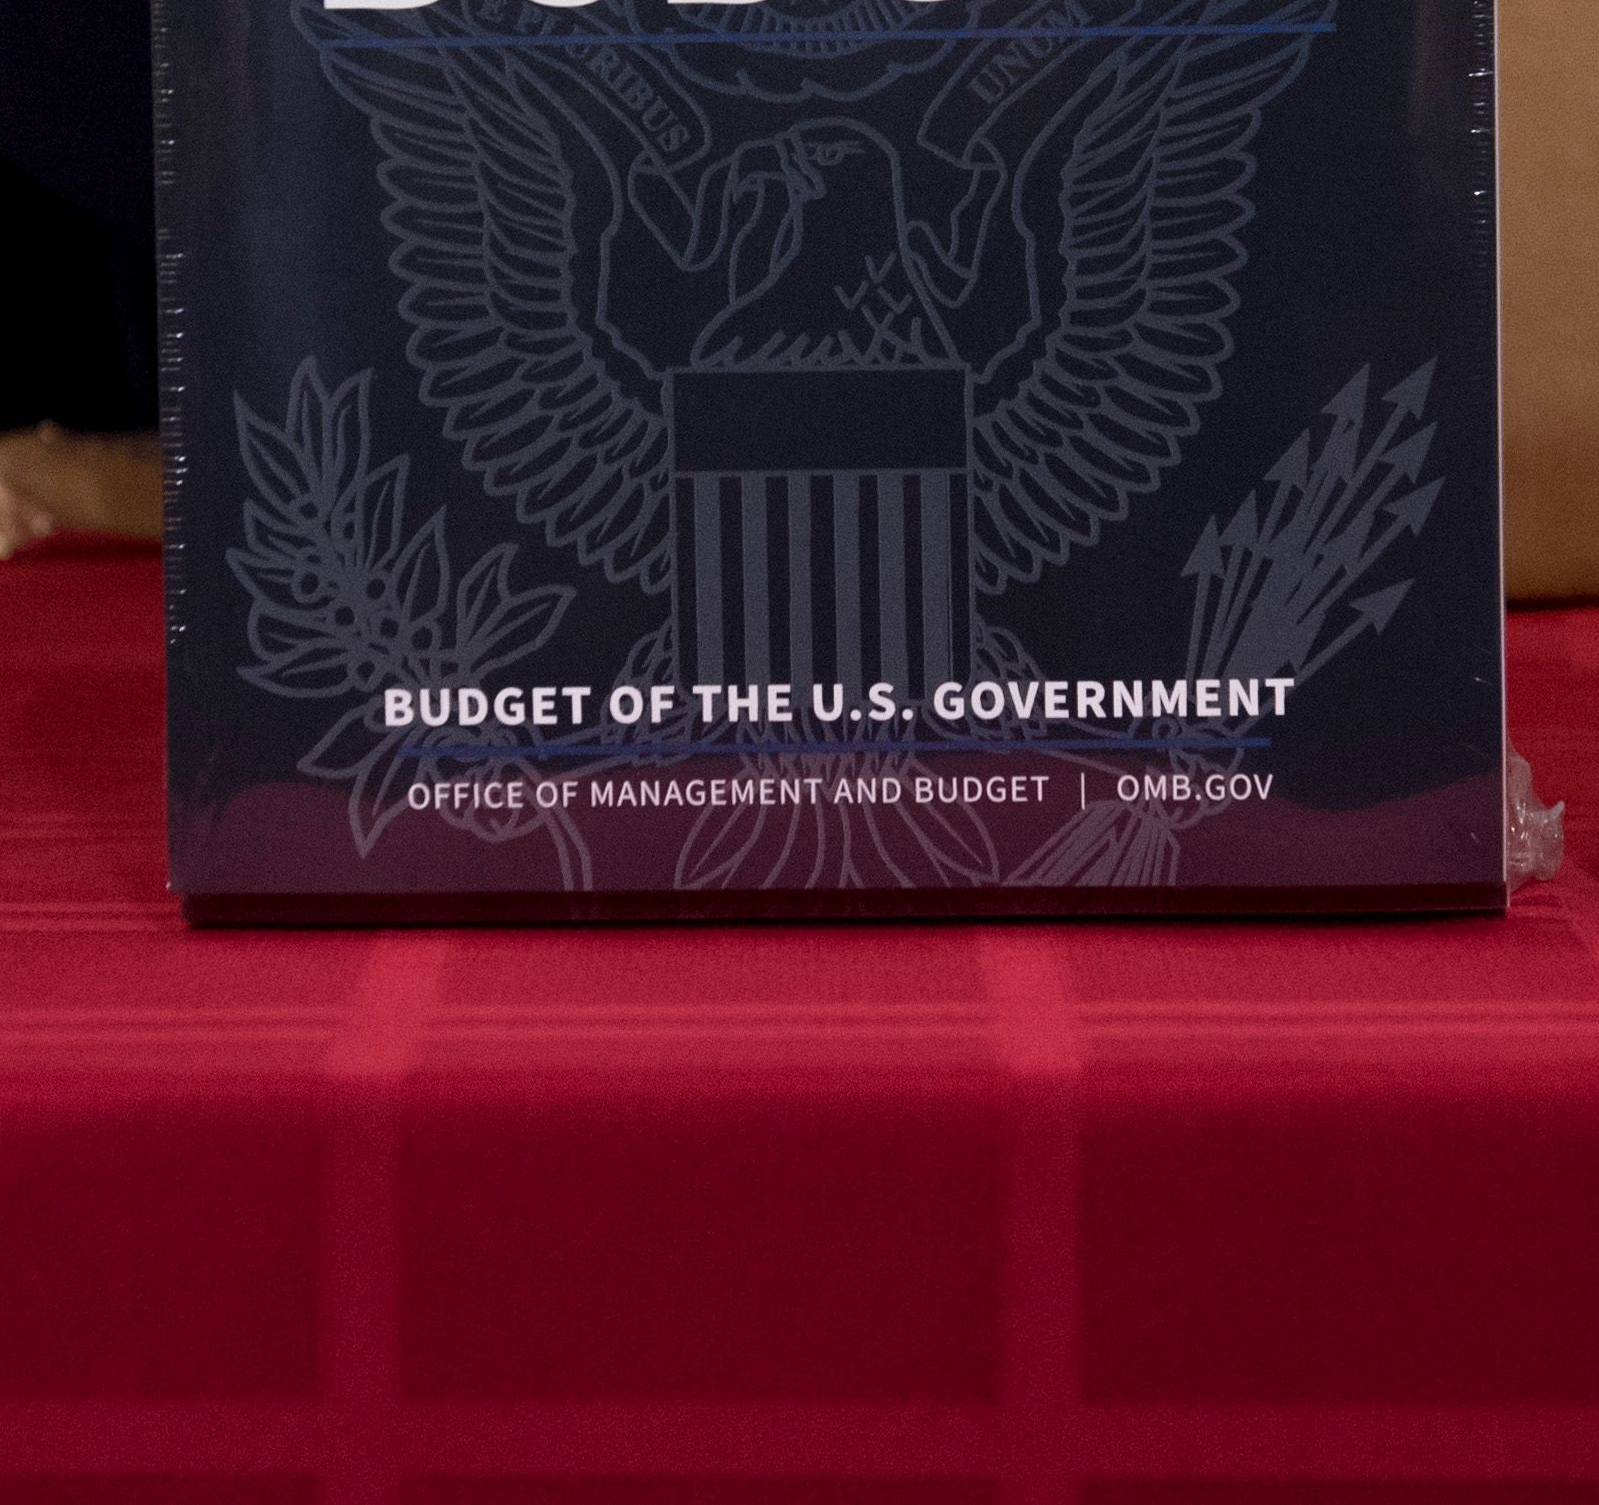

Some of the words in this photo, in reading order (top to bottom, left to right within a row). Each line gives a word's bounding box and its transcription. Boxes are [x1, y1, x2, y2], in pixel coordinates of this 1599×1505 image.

[385, 687, 591, 726] BUDGET
[610, 686, 674, 724] OF
[693, 684, 792, 722] THE
[813, 682, 913, 721] U.S.
[934, 678, 1294, 720] GOVERNMENT
[408, 782, 523, 810] OFFICE
[536, 781, 578, 808] OF
[591, 778, 822, 807] MANAGEMENT
[834, 777, 901, 803] AND
[915, 776, 1049, 803] BUDGET
[1117, 774, 1273, 801] OMB.GOV
